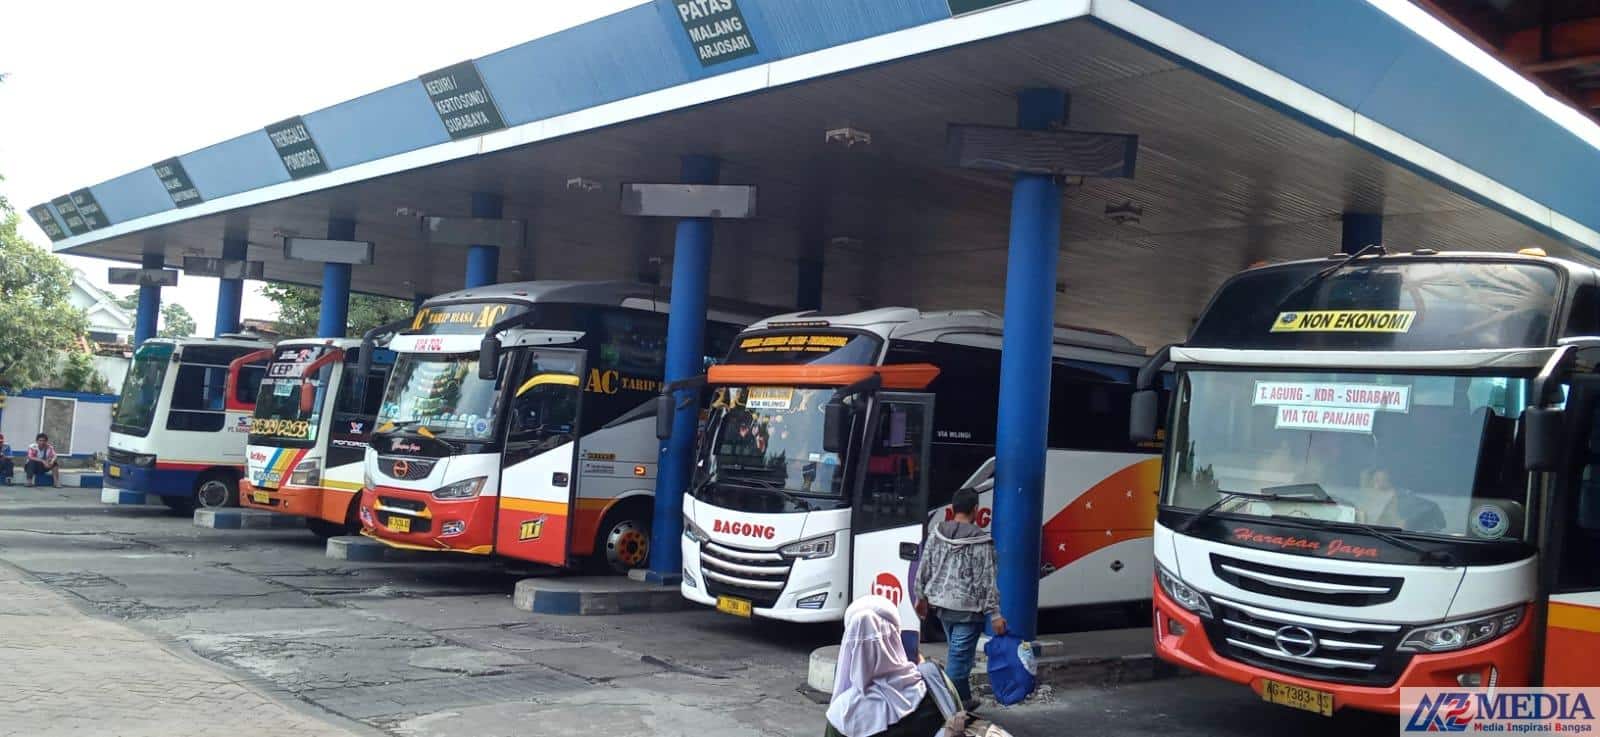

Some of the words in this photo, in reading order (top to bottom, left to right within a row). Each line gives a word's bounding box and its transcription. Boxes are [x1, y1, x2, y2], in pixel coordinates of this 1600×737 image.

[678, 0, 732, 22] PATAS
[688, 17, 742, 43] MALANG
[699, 35, 751, 60] ARJOSARI
[445, 111, 490, 133] SURABAYA
[473, 303, 507, 329] AC
[1300, 313, 1334, 329] NON
[1334, 313, 1409, 330] EKONOMI
[584, 368, 619, 394] AC
[1260, 386, 1268, 400] T.
[1270, 387, 1304, 401] AGUNG
[1314, 388, 1335, 402] KDR
[1345, 389, 1401, 406] SURABAYA
[1281, 408, 1298, 423] VIA
[1302, 410, 1319, 424] TOL
[1322, 411, 1370, 427] PANJANG
[937, 430, 949, 438] VIA
[713, 519, 775, 540] BAGONG
[1232, 527, 1321, 549] Harapan
[1327, 538, 1377, 558] Jaya
